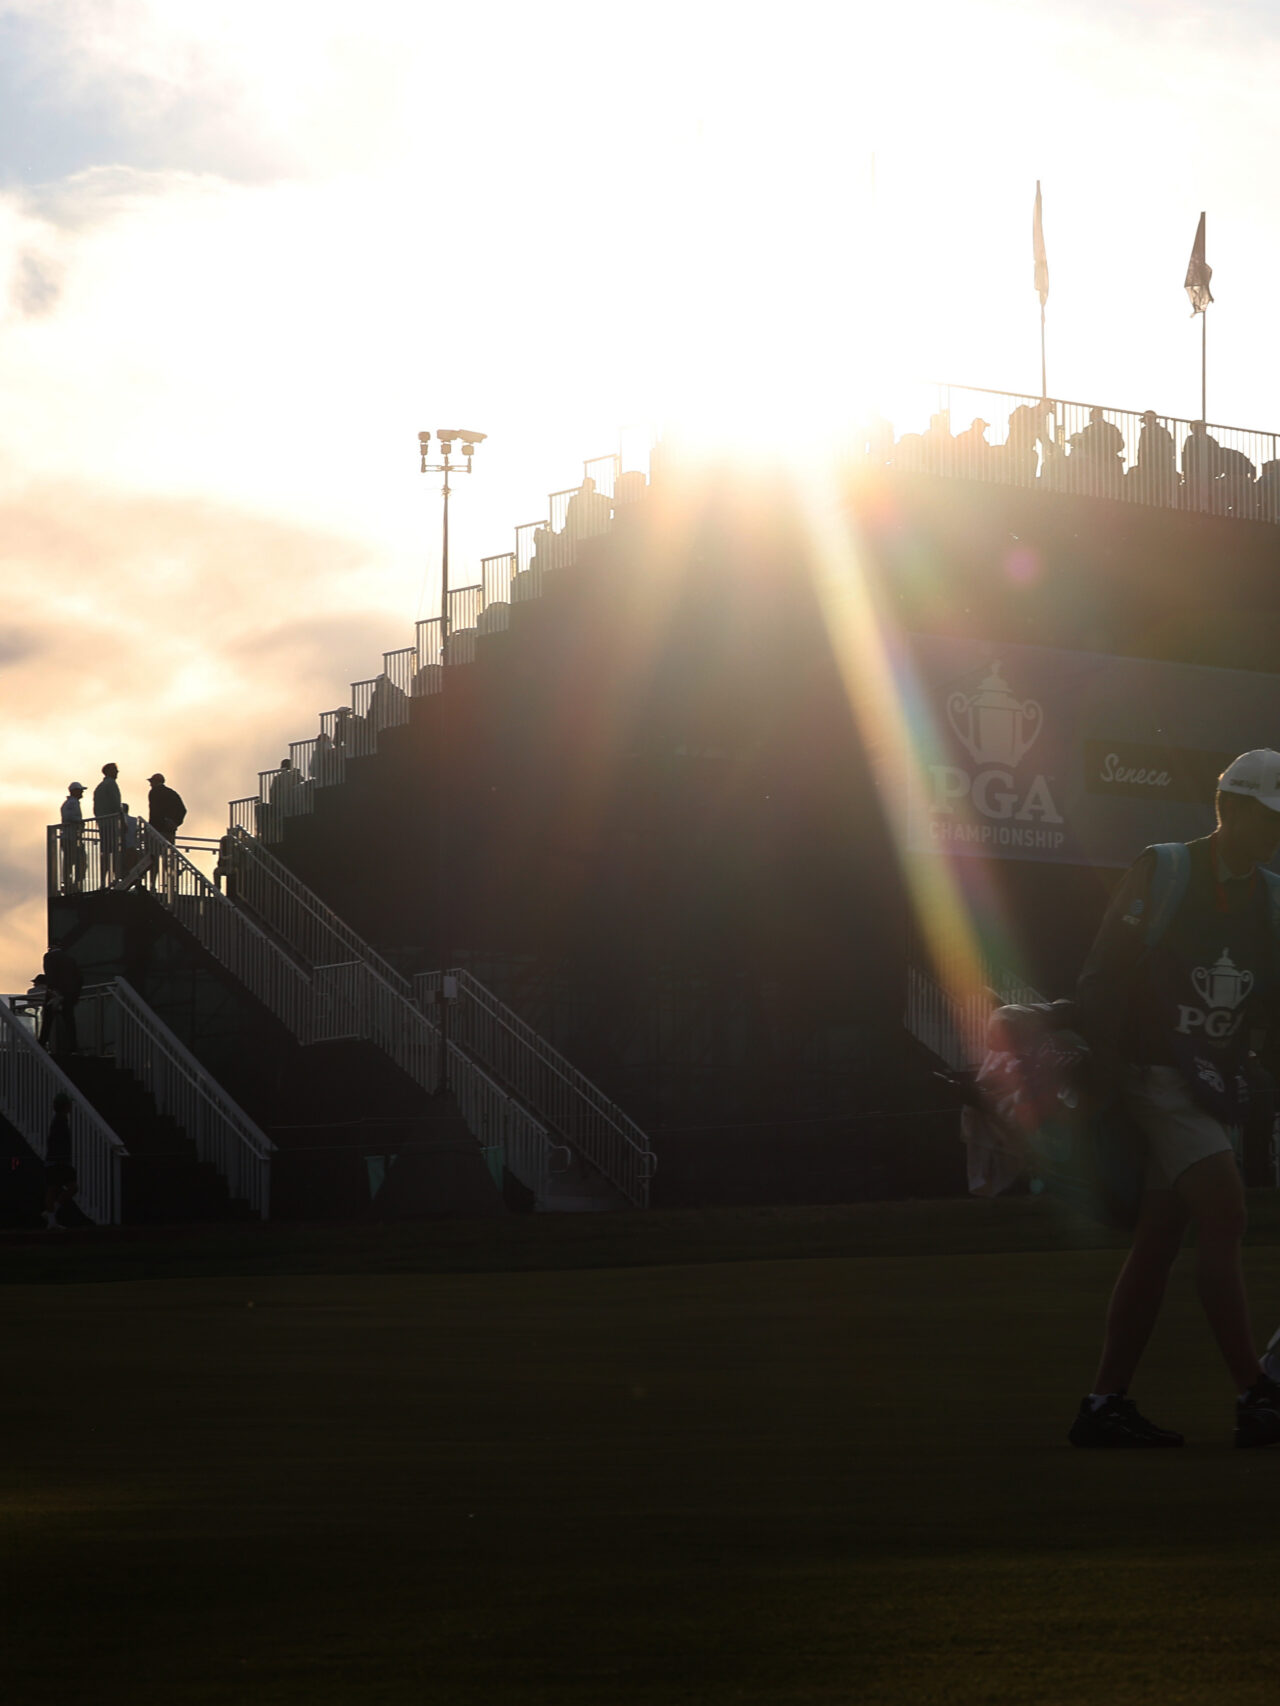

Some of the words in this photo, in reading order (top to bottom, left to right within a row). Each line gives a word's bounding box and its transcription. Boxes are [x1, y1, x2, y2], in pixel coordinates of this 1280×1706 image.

[1100, 753, 1172, 786] Seneca
[928, 765, 1064, 824] PGA
[929, 821, 1064, 849] CHAMPIONSHIP
